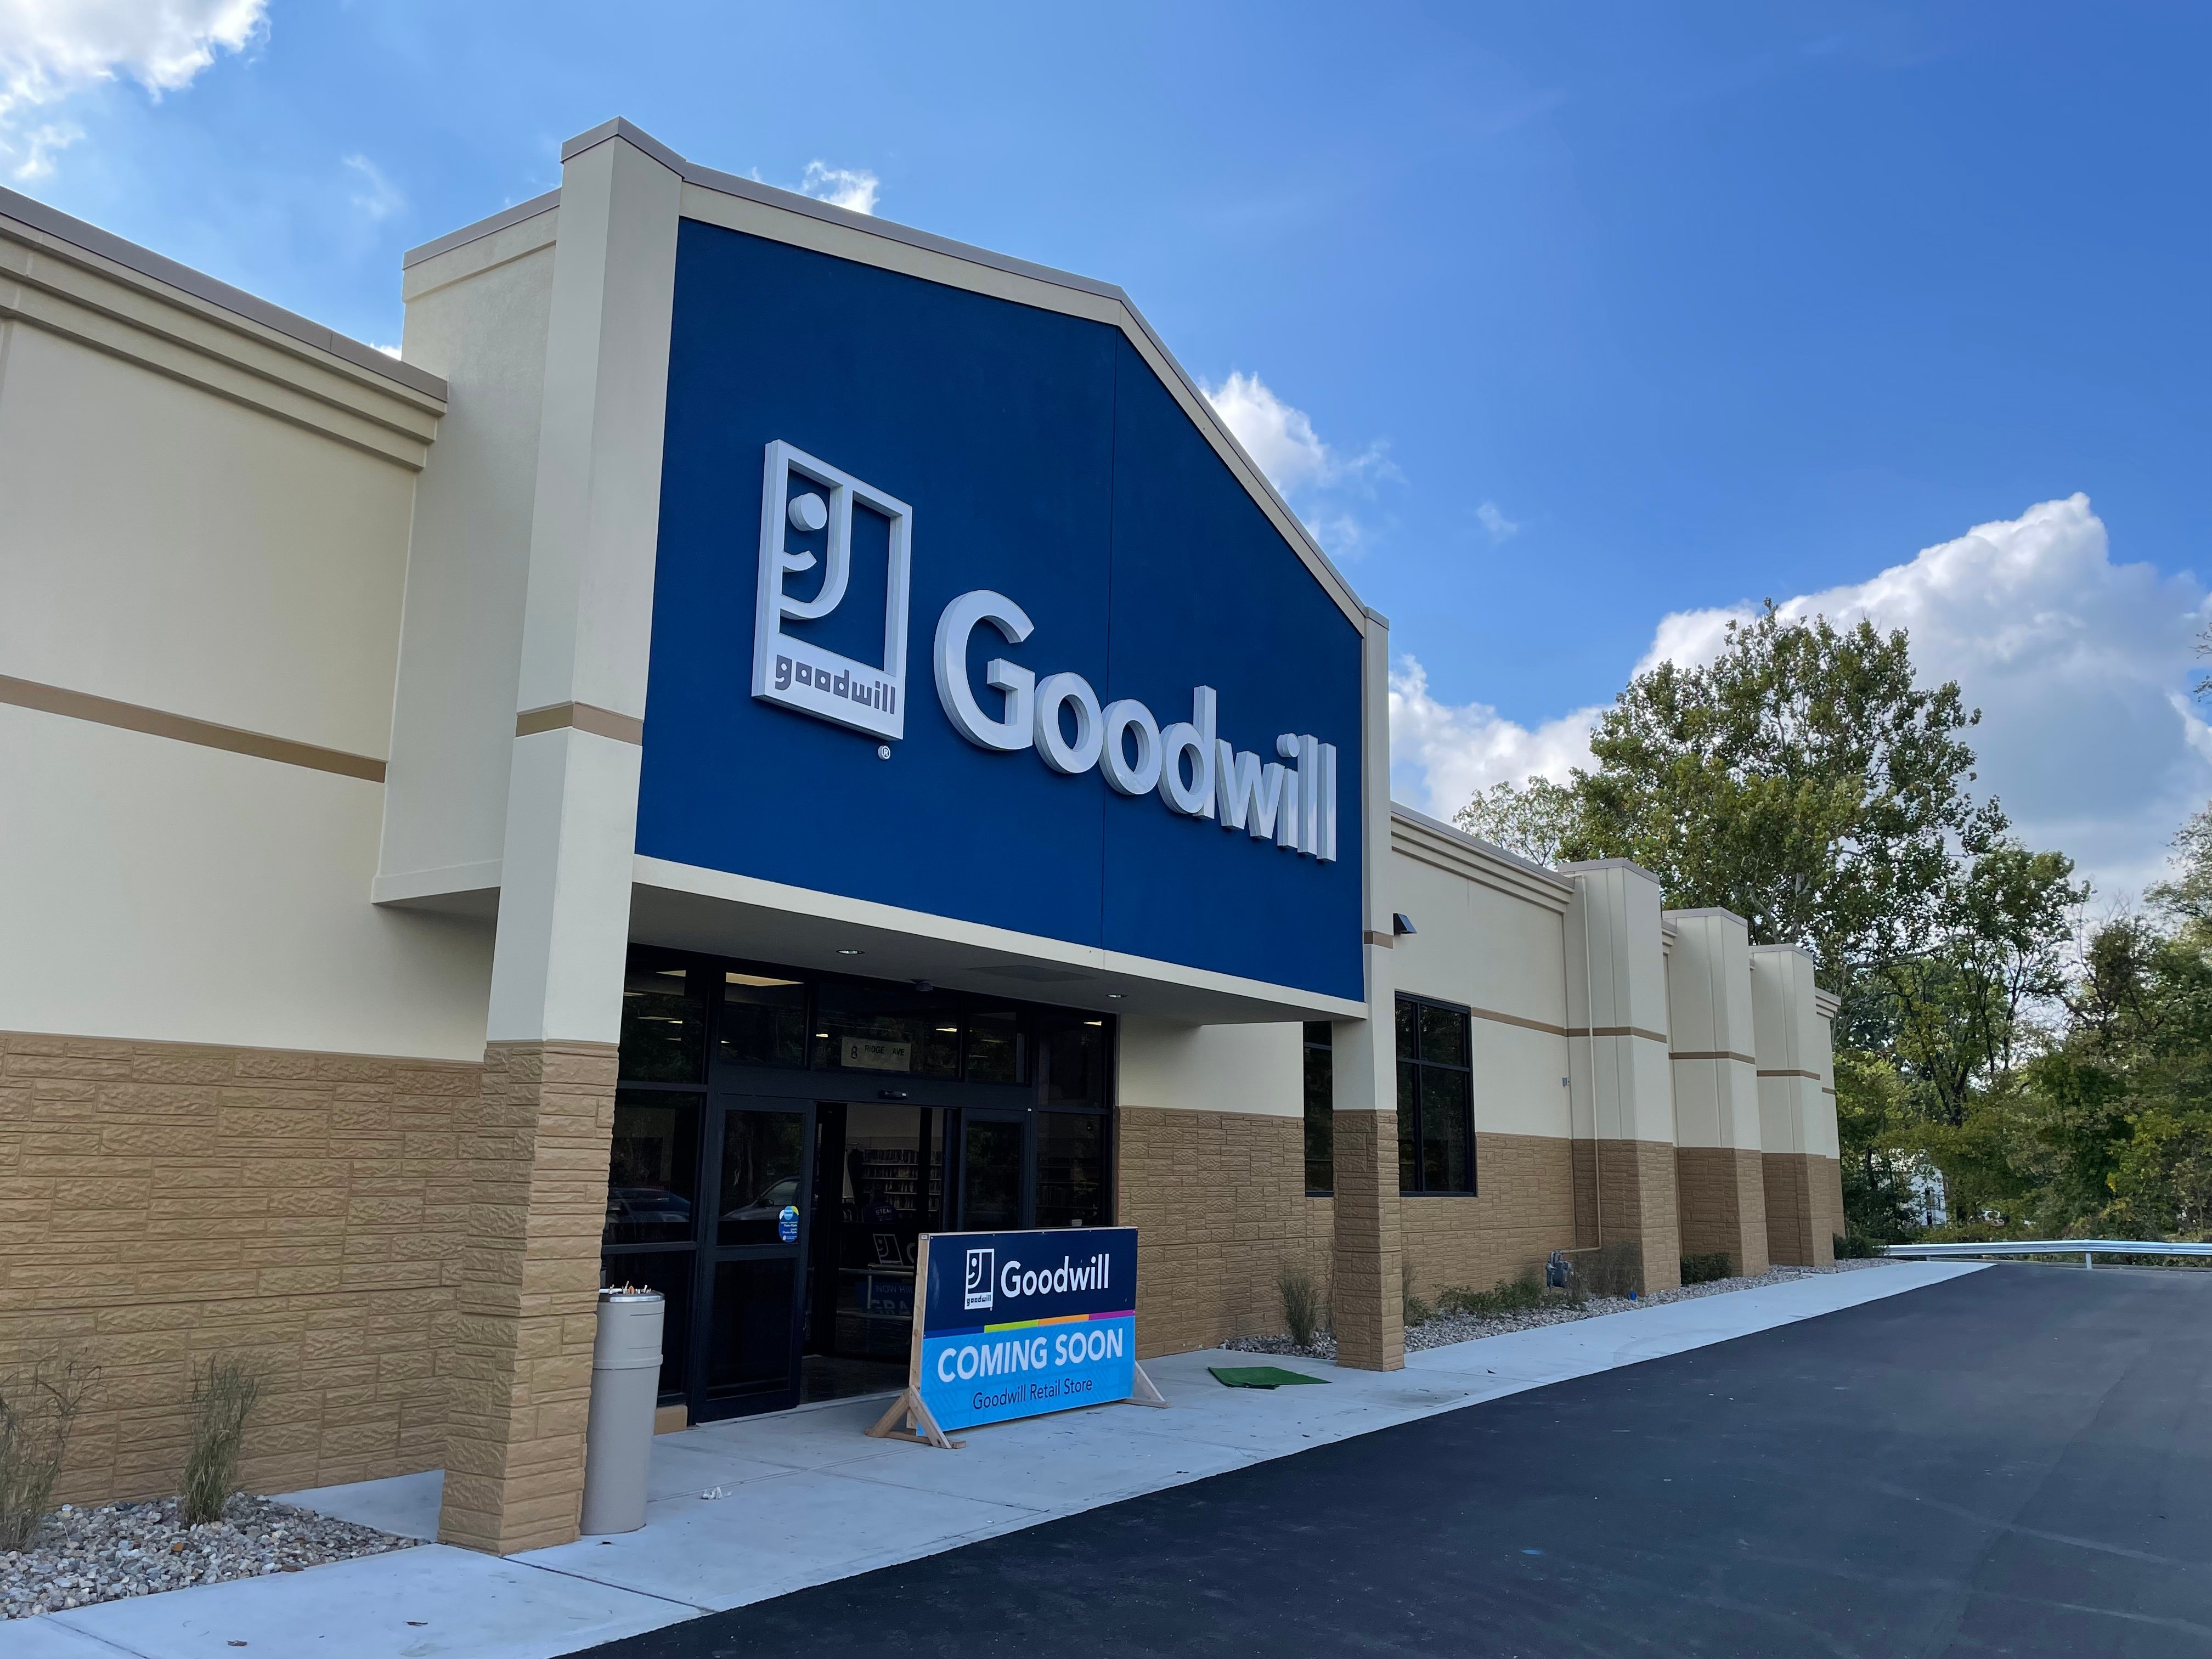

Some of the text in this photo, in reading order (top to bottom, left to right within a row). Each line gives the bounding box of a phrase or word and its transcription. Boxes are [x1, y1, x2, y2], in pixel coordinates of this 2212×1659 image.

[775, 654, 895, 715] goodwill
[934, 590, 1336, 862] Goodwill
[865, 1045, 885, 1054] RIDGE
[892, 1048, 905, 1056] AVE
[1001, 1254, 1109, 1298] Goodwill
[967, 1295, 991, 1307] goodwill
[938, 1328, 1124, 1383] COMING SOON
[973, 1378, 1092, 1409] Goodwill Retail Store
